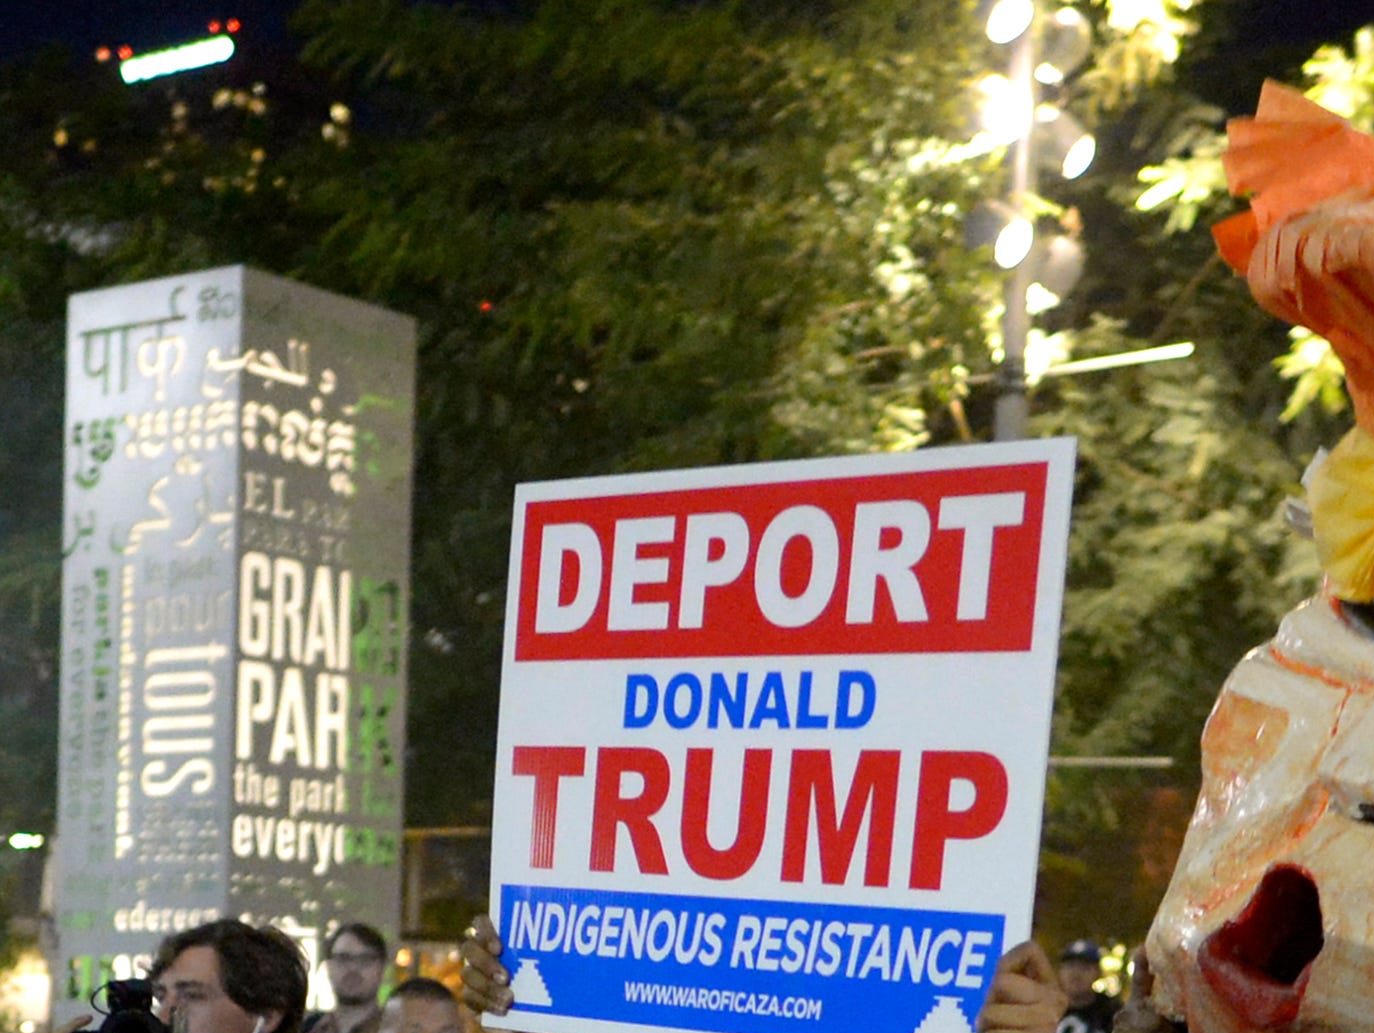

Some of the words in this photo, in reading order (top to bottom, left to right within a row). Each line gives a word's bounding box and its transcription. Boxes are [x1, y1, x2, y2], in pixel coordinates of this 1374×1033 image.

[244, 470, 295, 519] EL
[534, 490, 1027, 635] DEPORT
[622, 670, 877, 730] DONALD
[232, 762, 280, 808] the
[511, 745, 1009, 892] TRUMP
[508, 901, 727, 968] INDIGENOUS
[729, 914, 994, 989] RESISTANCE
[623, 981, 823, 1022] WWW.WAROFICAZA.COM
